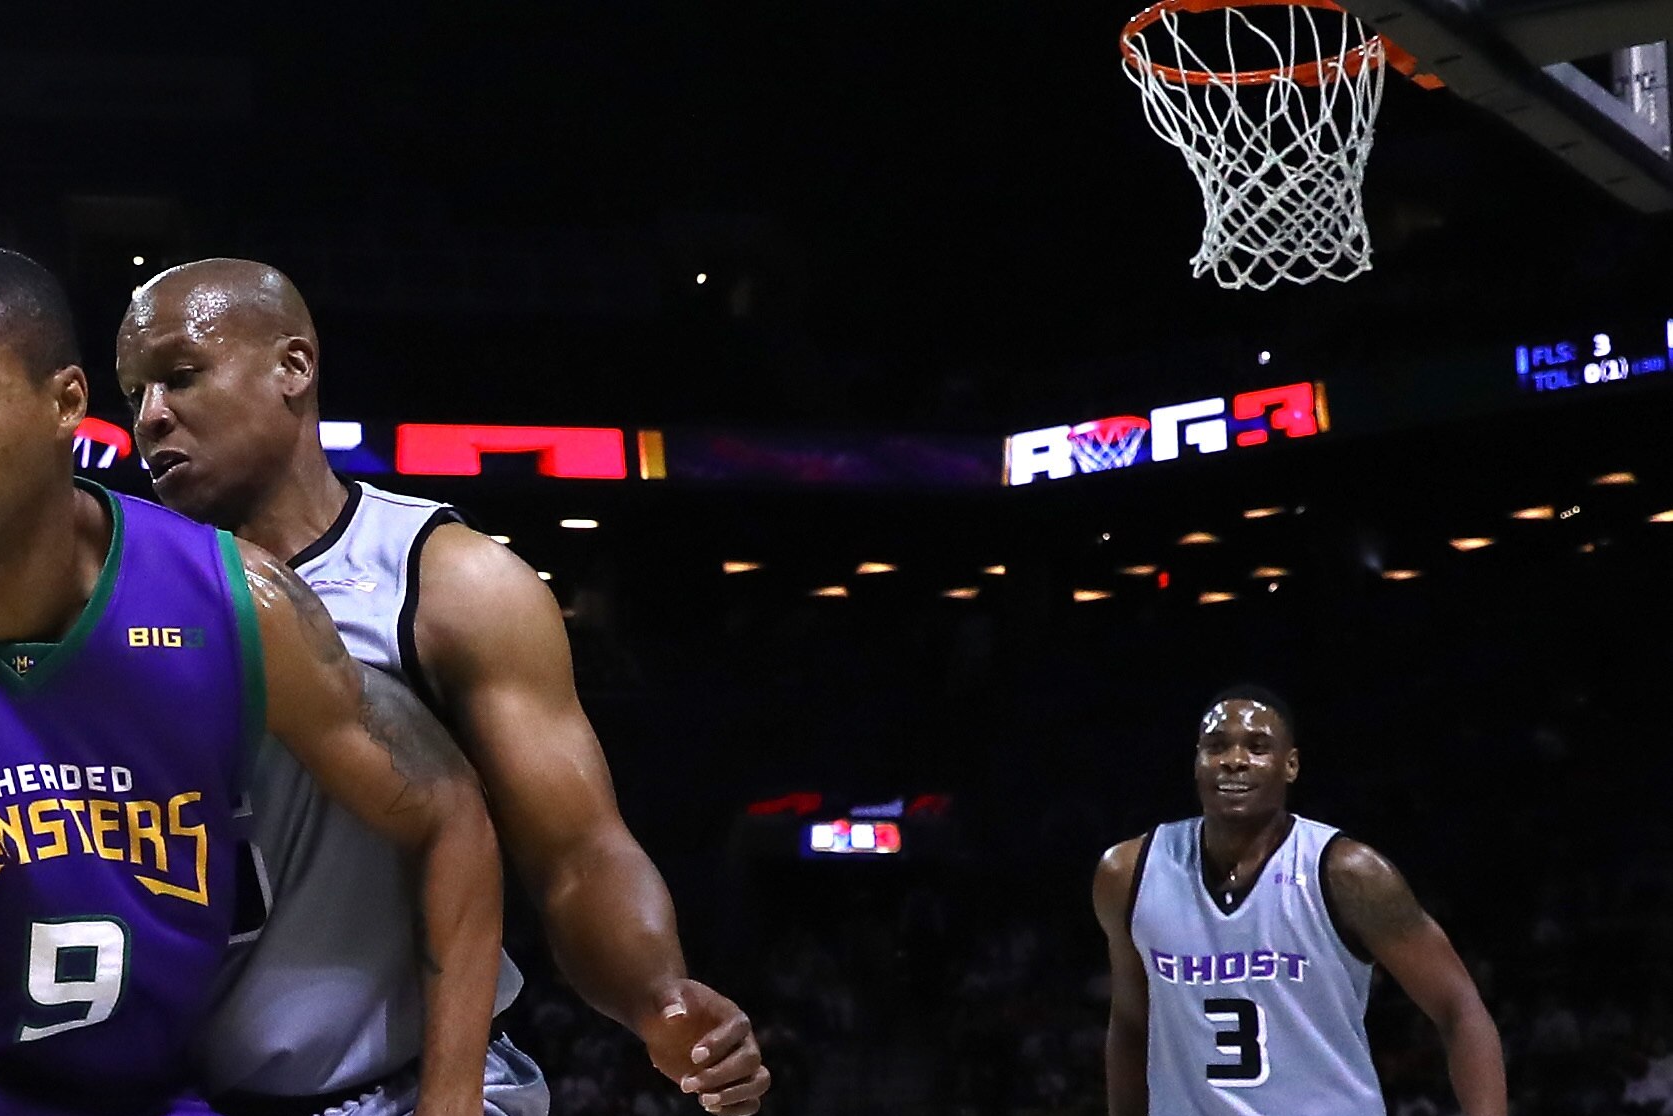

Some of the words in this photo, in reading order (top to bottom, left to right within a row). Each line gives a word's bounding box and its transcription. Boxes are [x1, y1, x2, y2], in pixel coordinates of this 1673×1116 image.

[1593, 333, 1611, 357] 3
[18, 919, 126, 1042] 9
[1150, 948, 1309, 985] GHOST
[1204, 998, 1270, 1087] 3
